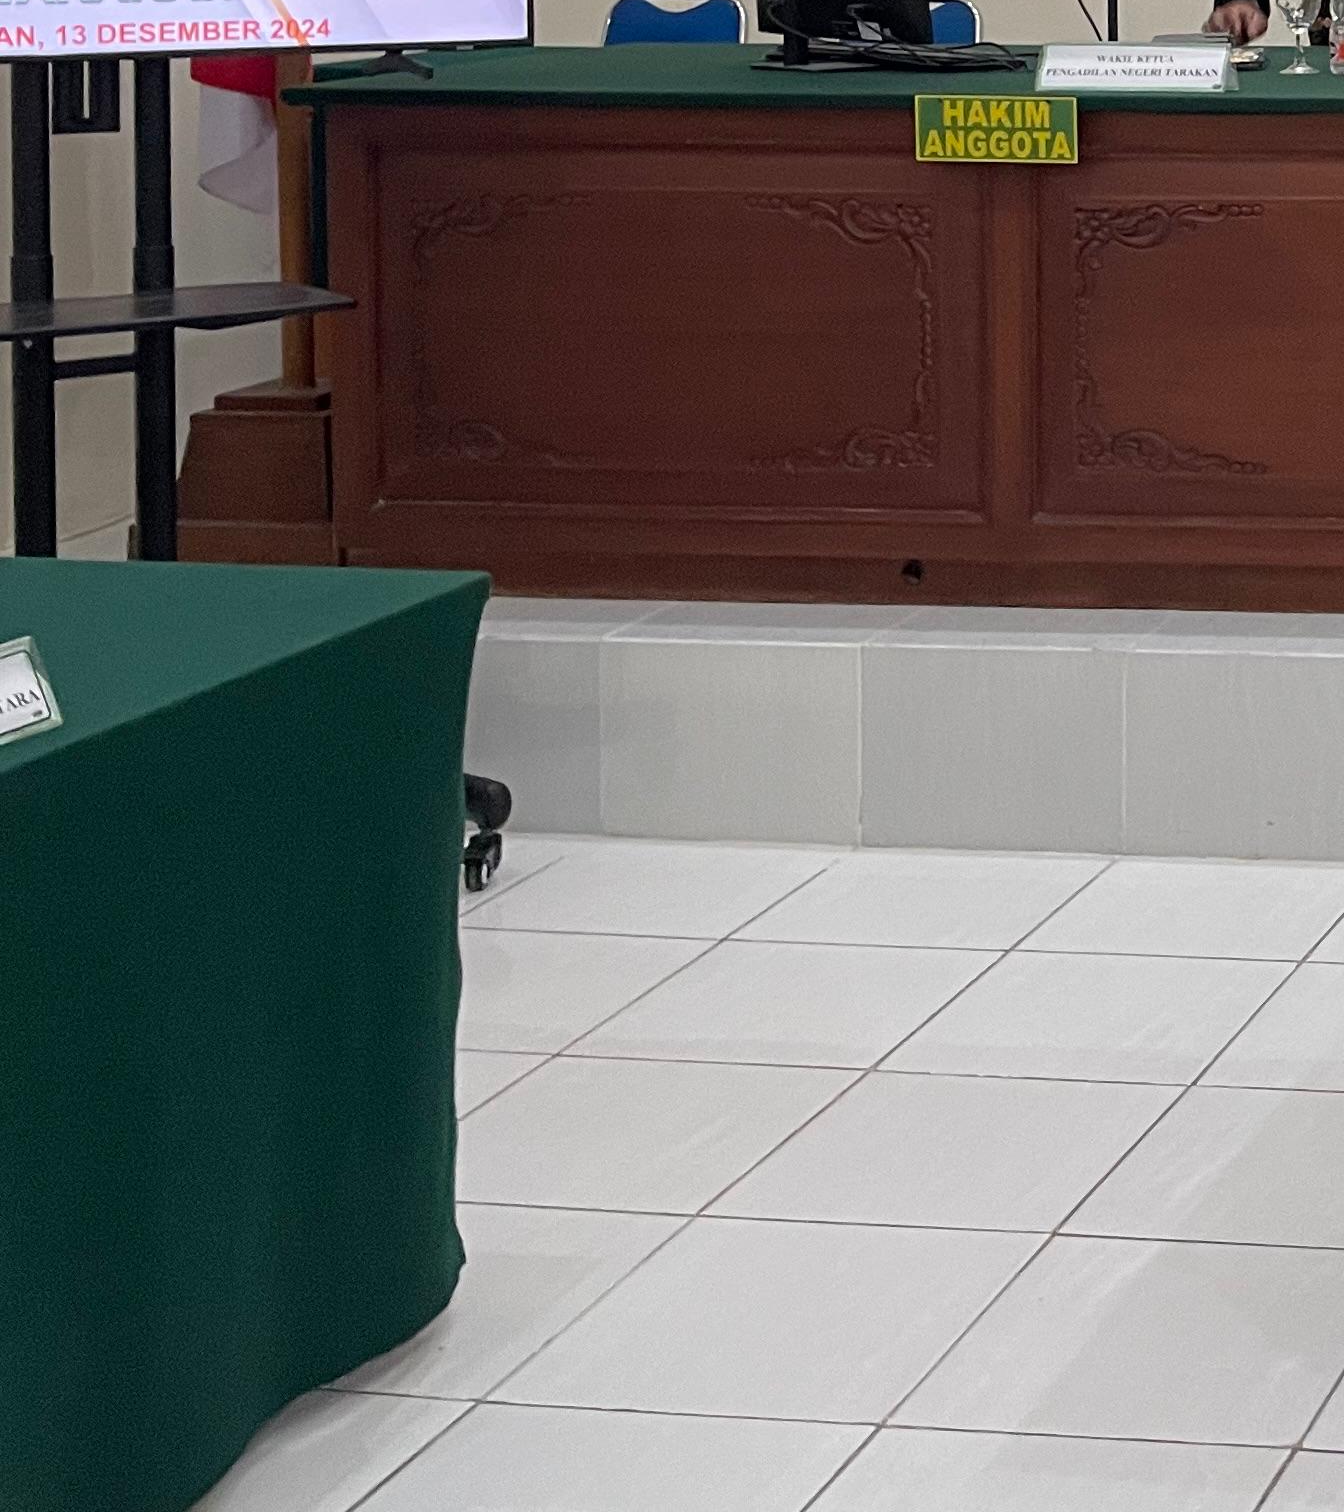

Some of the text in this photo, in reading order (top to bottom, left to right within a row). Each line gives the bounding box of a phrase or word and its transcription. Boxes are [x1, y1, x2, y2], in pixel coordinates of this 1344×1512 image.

[56, 25, 87, 46] 13
[97, 20, 262, 44] DESEMBER
[270, 18, 331, 40] 2024
[1046, 68, 1219, 77] PENGADILAN NEGERI TARAKAN
[942, 99, 1051, 129] HAKIM
[923, 129, 1072, 159] ANGGOTA
[0, 689, 40, 714] ARA
